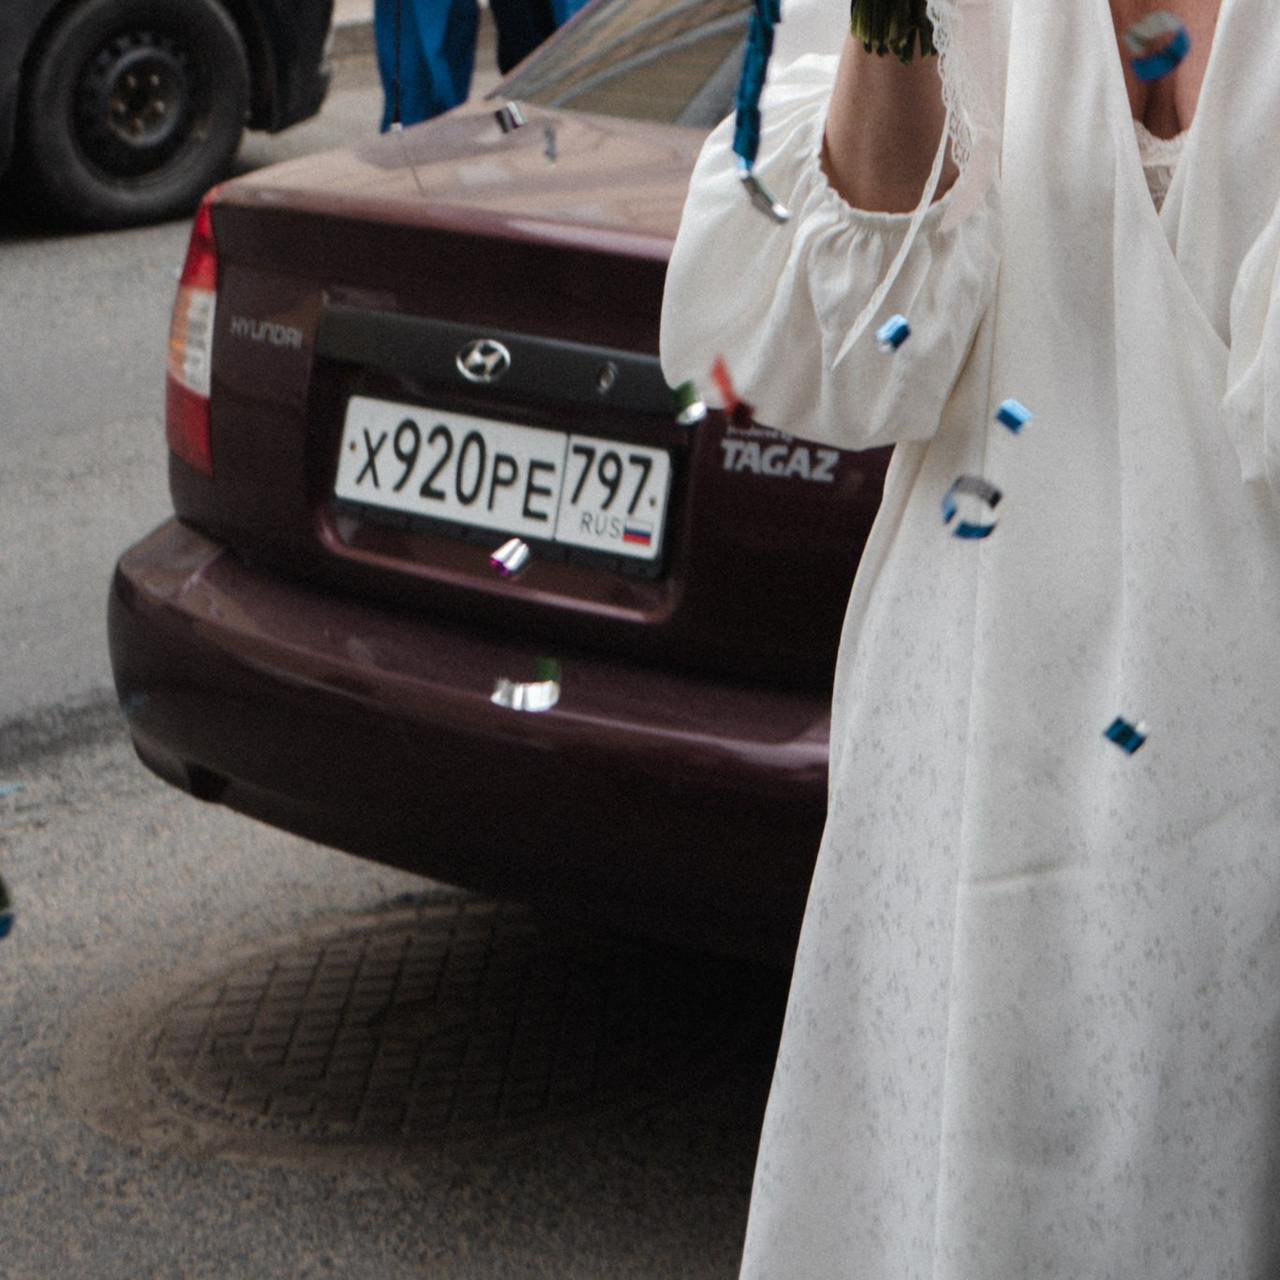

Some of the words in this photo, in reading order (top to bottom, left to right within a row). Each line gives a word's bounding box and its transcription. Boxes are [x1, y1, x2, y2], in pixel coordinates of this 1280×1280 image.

[571, 444, 652, 515] 797
[721, 438, 839, 482] TAGAZ
[580, 512, 621, 540] RUS
